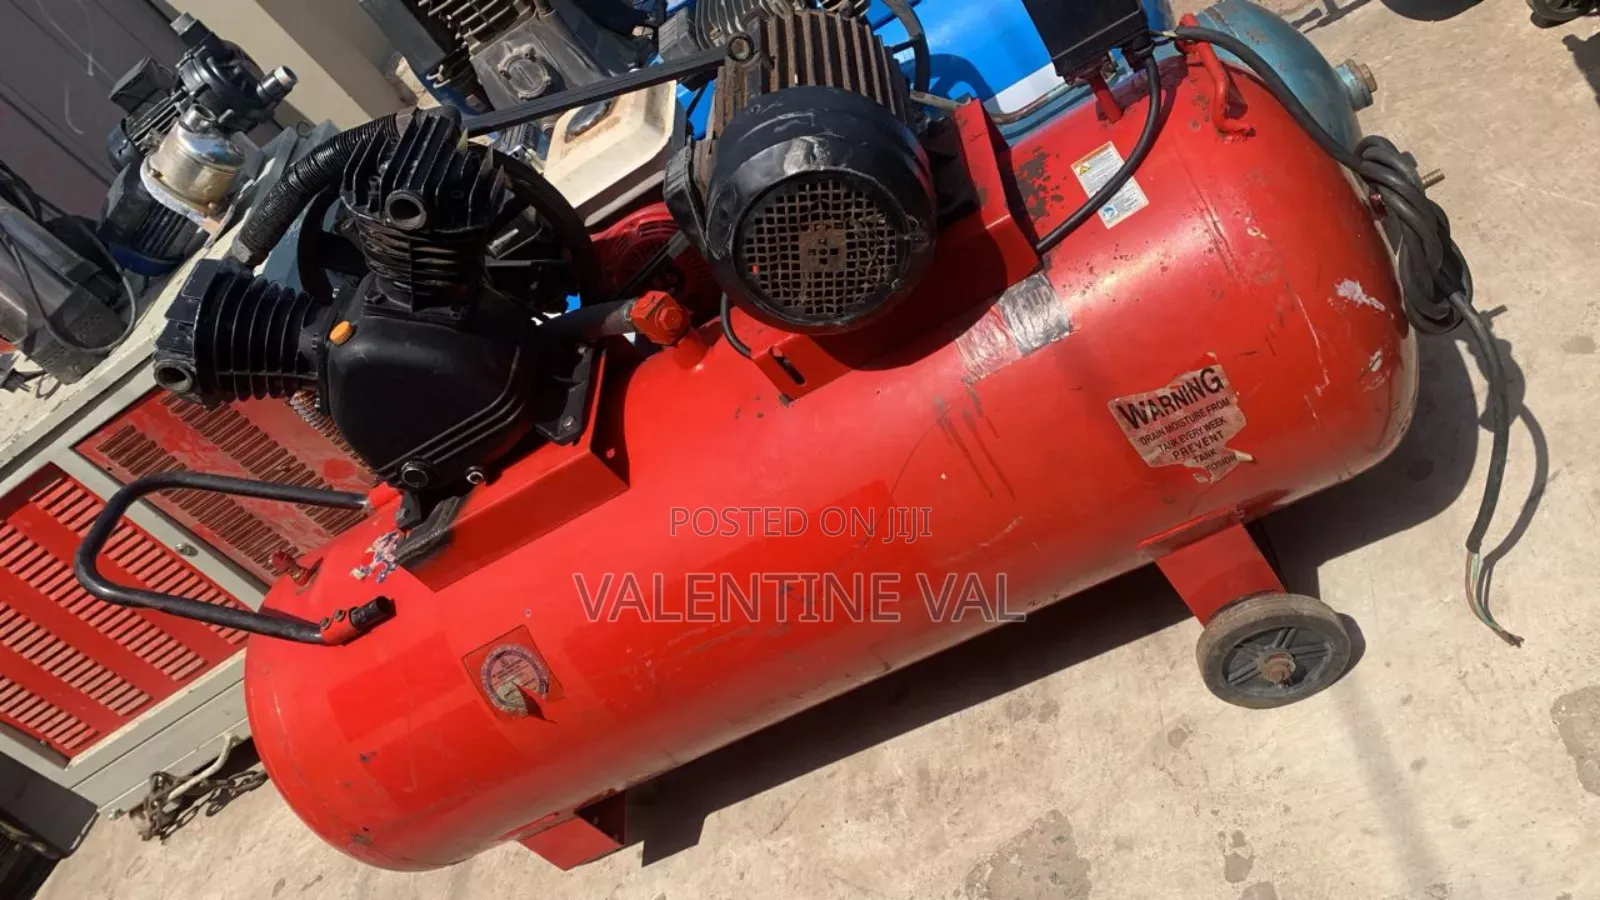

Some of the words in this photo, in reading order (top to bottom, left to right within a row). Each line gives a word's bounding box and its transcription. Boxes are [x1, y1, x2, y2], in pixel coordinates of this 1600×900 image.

[1116, 367, 1224, 429] WARNING
[1139, 430, 1166, 446] DRAIN
[1164, 408, 1206, 435] MOISTURE
[1206, 397, 1231, 415] FROM
[1158, 438, 1181, 453] TANK
[1179, 426, 1203, 443] EVERY
[1204, 416, 1227, 432] WEEK
[1173, 431, 1224, 460] PREVENT
[1193, 448, 1217, 463] TANK
